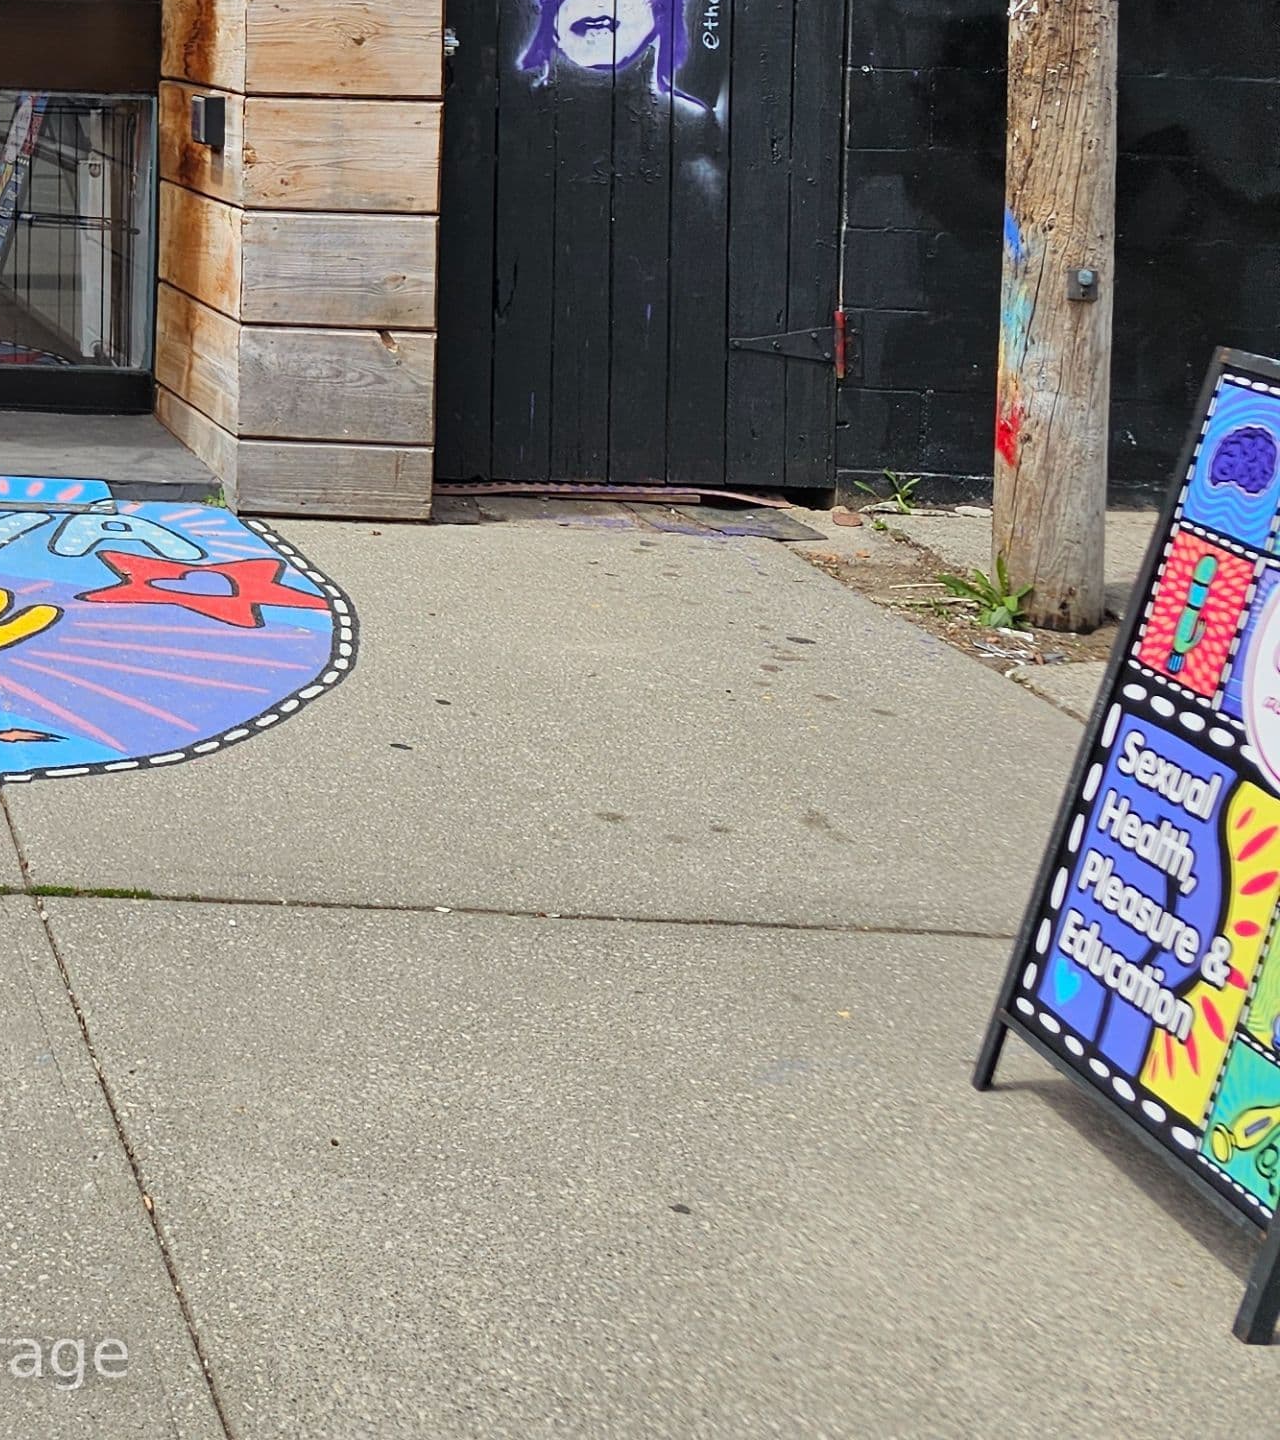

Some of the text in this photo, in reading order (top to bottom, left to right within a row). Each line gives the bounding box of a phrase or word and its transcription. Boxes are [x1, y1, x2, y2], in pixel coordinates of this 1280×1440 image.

[1117, 730, 1223, 821] Sexual
[1097, 789, 1197, 895] Health,
[1057, 909, 1195, 1043] Education
[1077, 849, 1232, 990] Pleasure &
